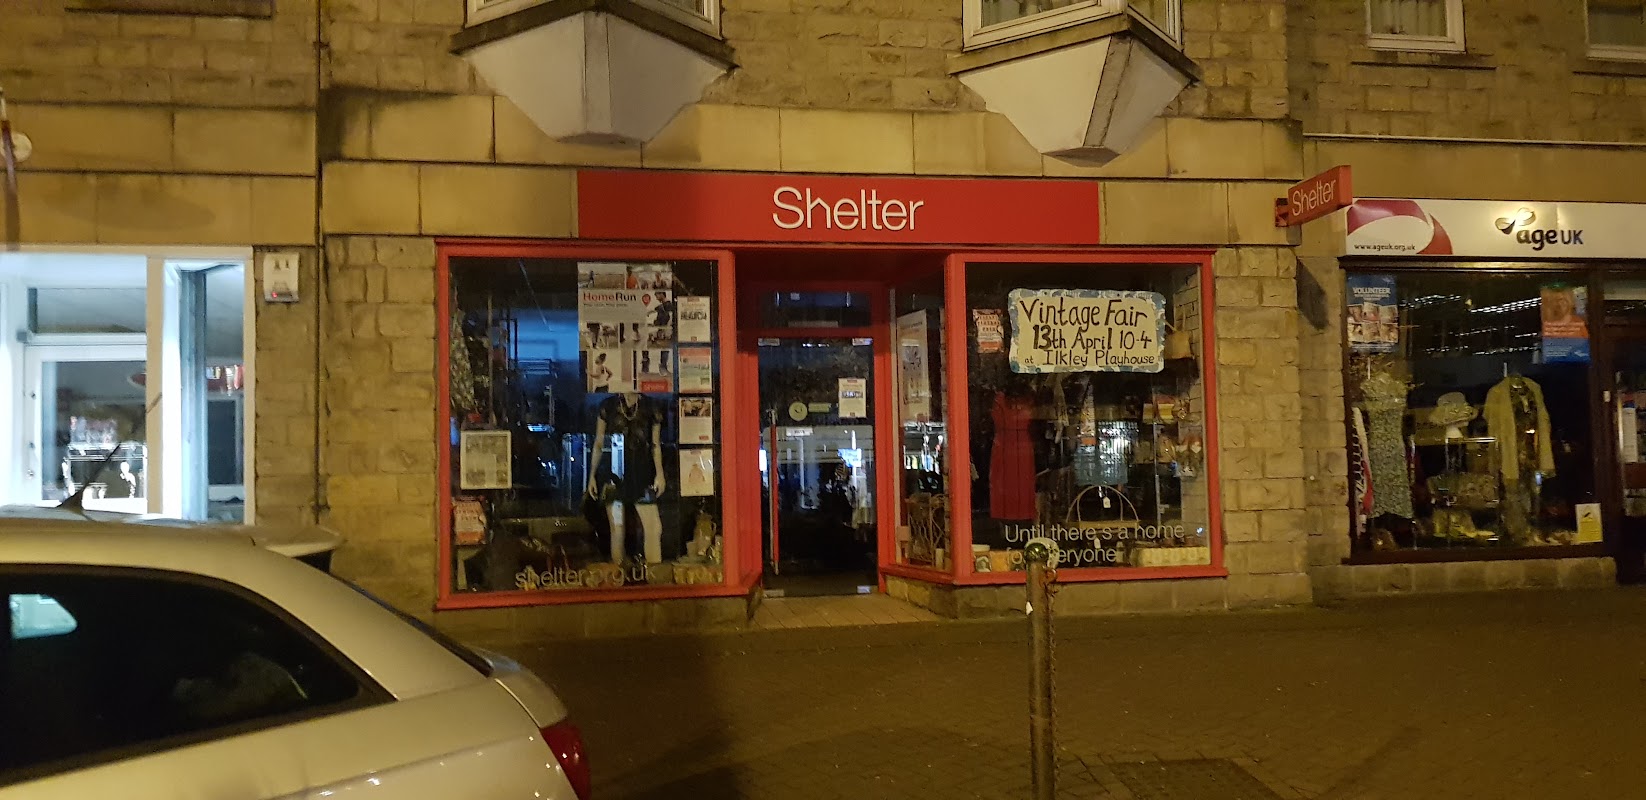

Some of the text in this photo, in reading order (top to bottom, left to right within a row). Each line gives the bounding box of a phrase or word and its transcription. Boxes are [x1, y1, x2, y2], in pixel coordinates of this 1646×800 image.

[772, 186, 924, 231] Shelter
[1292, 179, 1337, 217] Shelter
[1353, 243, 1416, 253] www.ageuk.org.uk
[1516, 229, 1584, 252] age UK
[583, 292, 637, 302] HomeRun
[1352, 286, 1392, 295] VOLUNTEER
[1019, 296, 1148, 333] Vintage Fair
[1033, 324, 1153, 355] 13th April 10-4
[1024, 349, 1155, 368] at Ilkley Playhouse
[1005, 523, 1046, 542] Until
[1118, 526, 1129, 540] a
[1134, 522, 1185, 539] home
